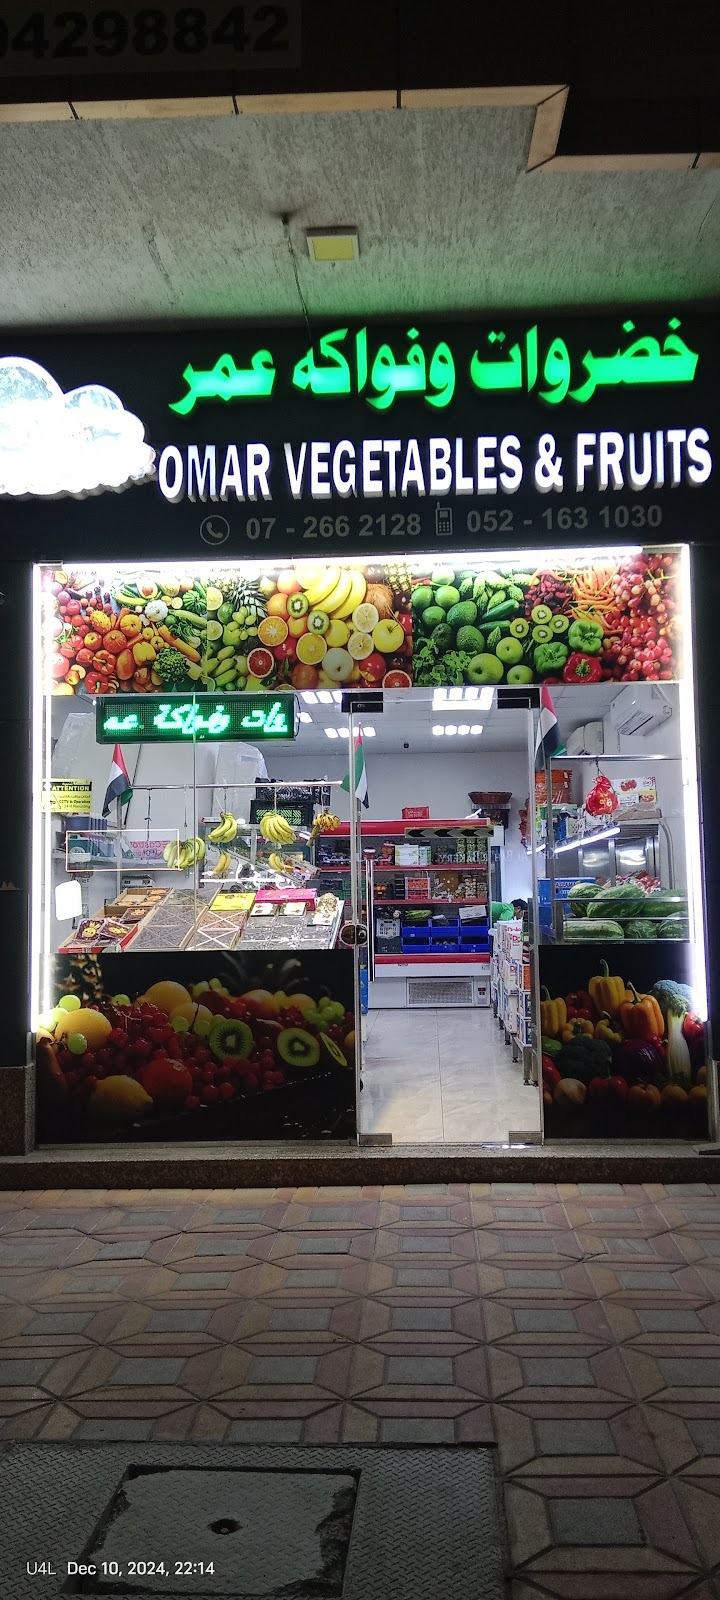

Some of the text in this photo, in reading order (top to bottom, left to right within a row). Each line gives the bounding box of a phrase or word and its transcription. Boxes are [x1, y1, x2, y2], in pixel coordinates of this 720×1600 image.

[0, 5, 290, 59] 4298842
[168, 317, 699, 416] خضروات وفواكه عمر
[158, 427, 712, 500] OMAR VEGETABLES & FRUITS
[246, 517, 276, 540] 07
[303, 515, 350, 538] 266
[358, 513, 421, 537] 2128
[466, 509, 514, 533] 052
[542, 507, 588, 531] 163
[599, 504, 663, 529] 1030
